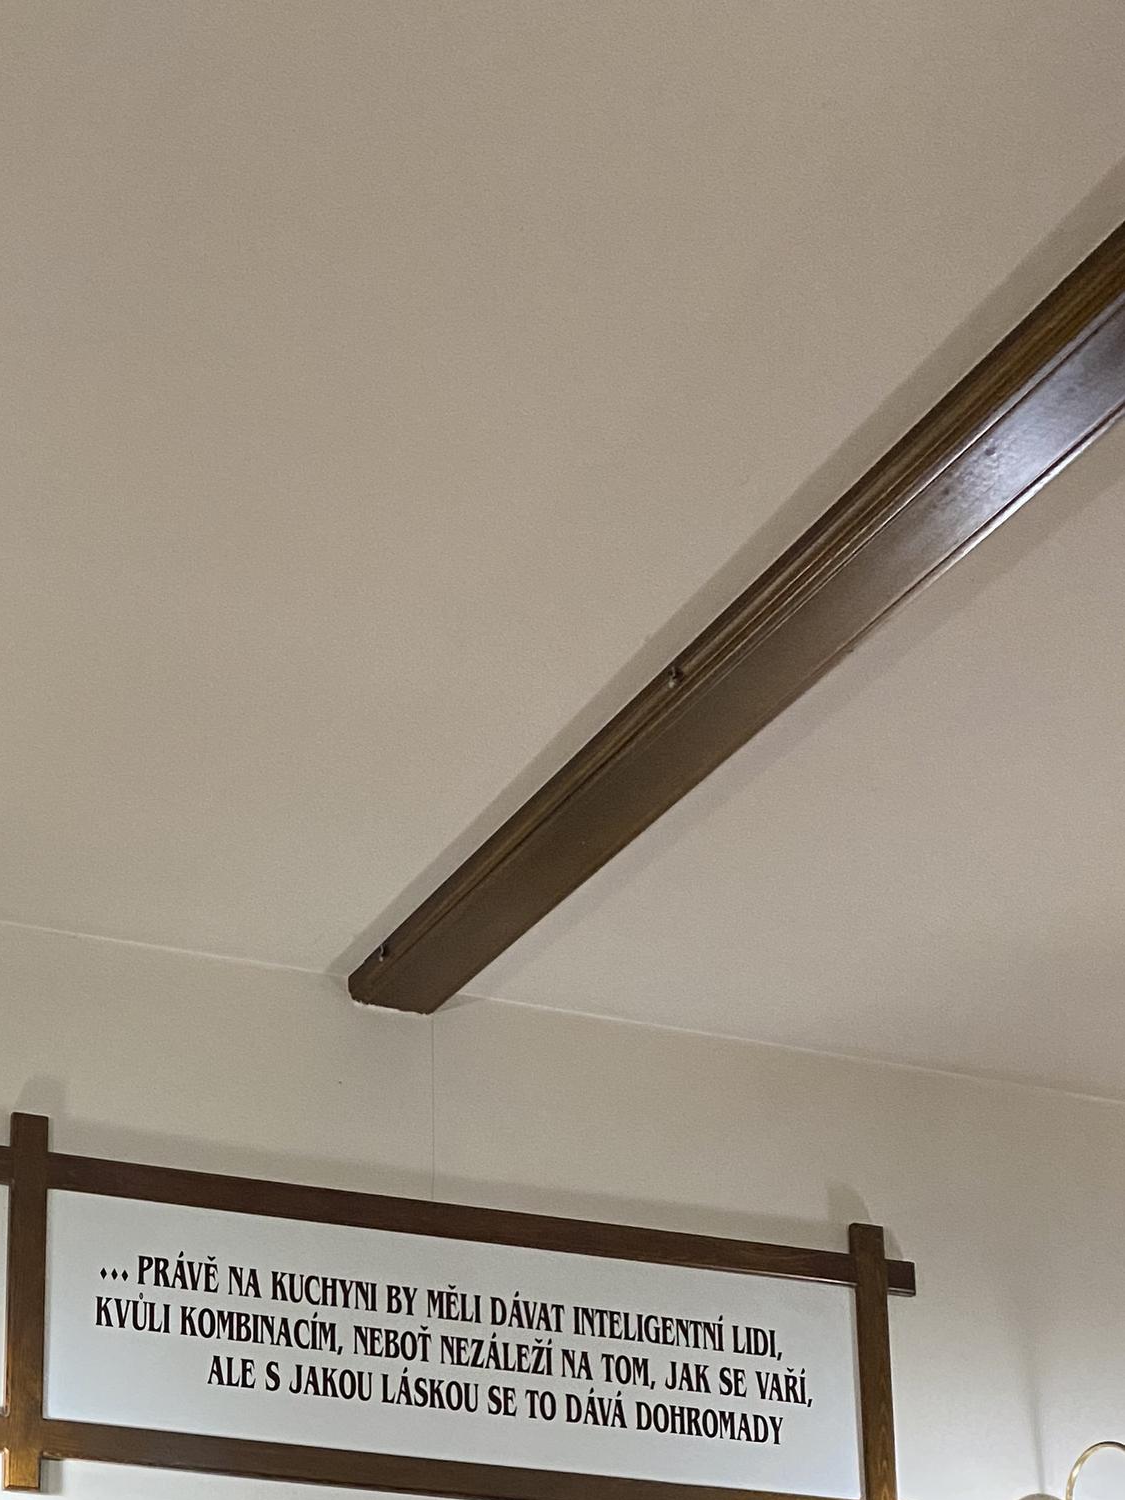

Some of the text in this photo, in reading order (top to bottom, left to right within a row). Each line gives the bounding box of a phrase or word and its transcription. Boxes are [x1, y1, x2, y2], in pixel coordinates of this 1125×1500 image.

[95, 1292, 813, 1408] KVŮLI KOMBINACÍM, NEBOŤ NEZÁLEŽÍ NA TOM, JAK SE VAŘÍ,
[137, 1250, 220, 1294] PRÁVĚ
[227, 1266, 262, 1299] NA
[271, 1270, 378, 1312] KUCHYNI
[386, 1284, 418, 1317] BY
[426, 1285, 482, 1324] MĚLI
[489, 1290, 565, 1333] DÁVAT
[572, 1306, 725, 1352] INTELIGENTNÍ
[731, 1325, 783, 1361] LIDI,
[207, 1355, 784, 1445] ALE S JAKOU LÁSKOU SE TO DÁVÁ DOHROMADY
